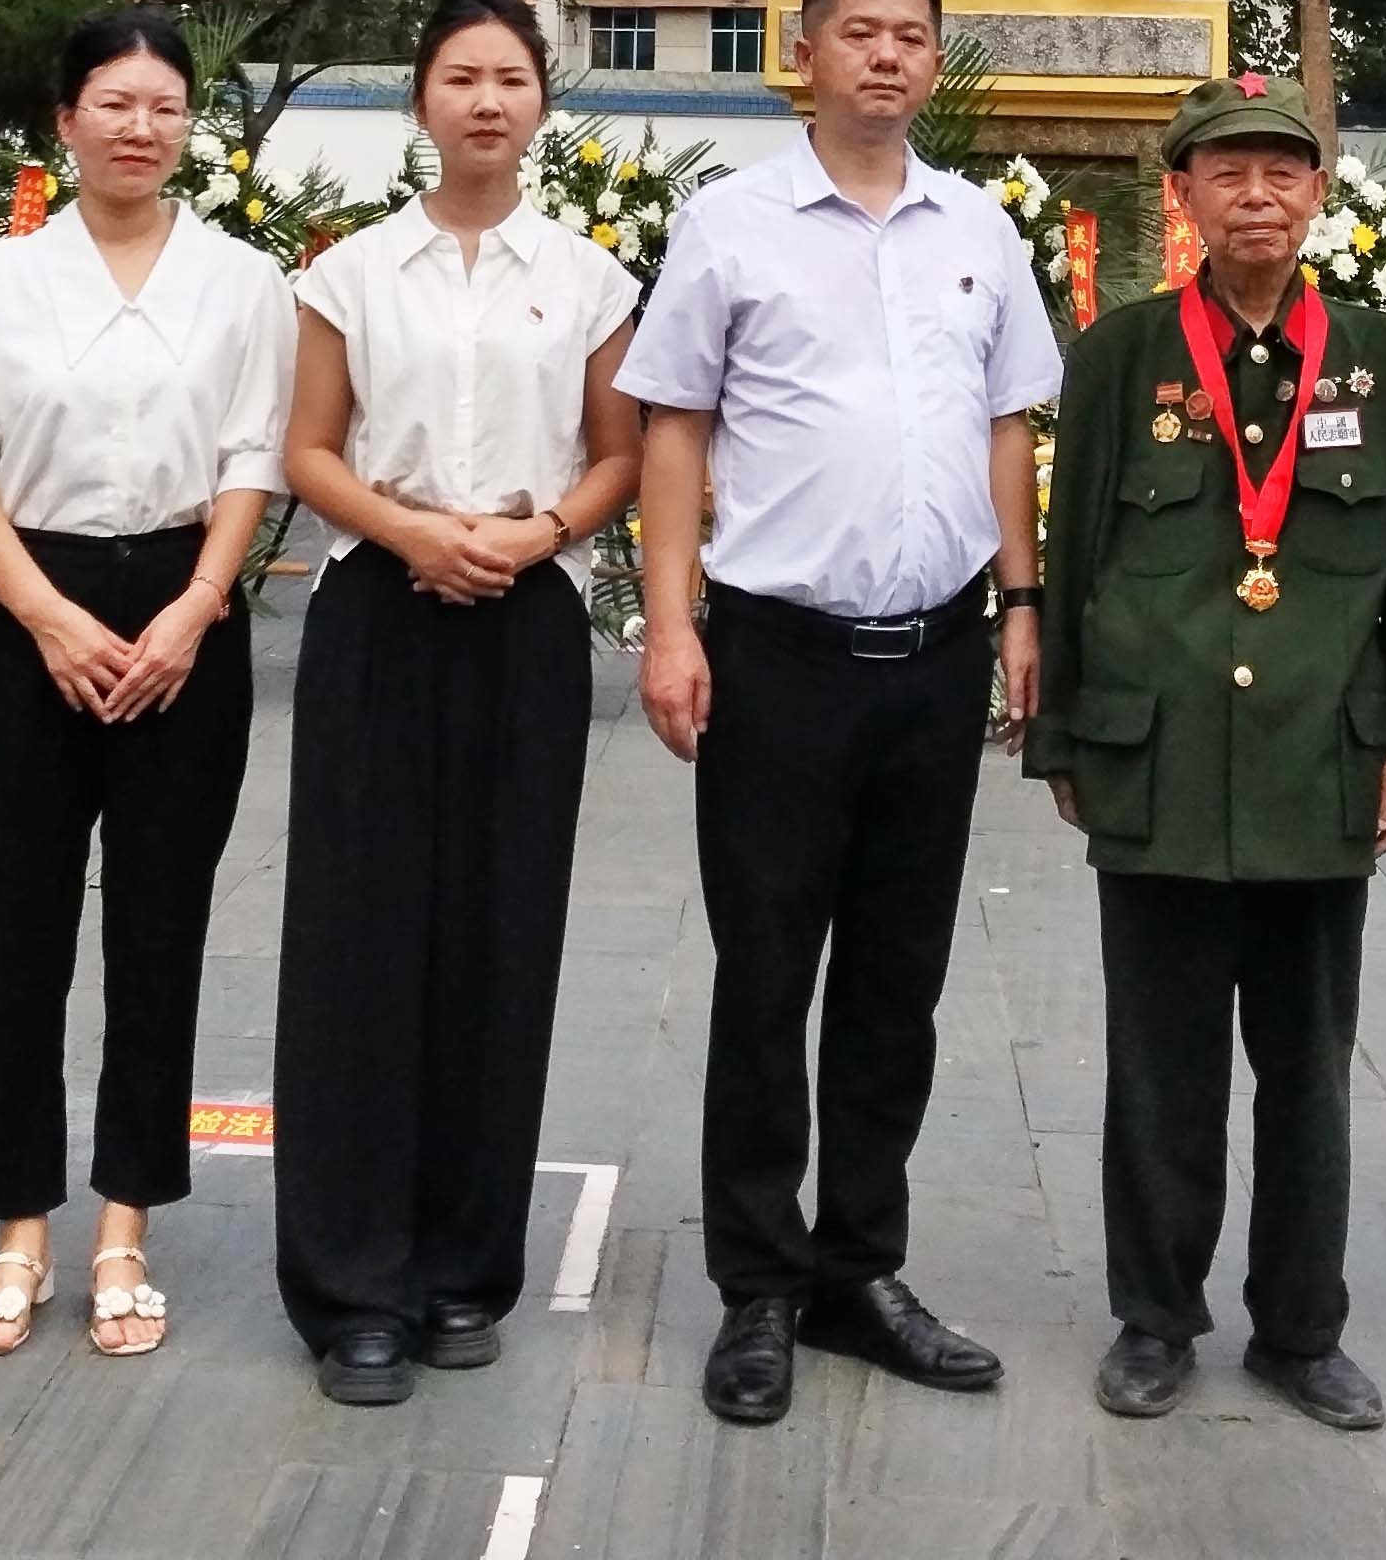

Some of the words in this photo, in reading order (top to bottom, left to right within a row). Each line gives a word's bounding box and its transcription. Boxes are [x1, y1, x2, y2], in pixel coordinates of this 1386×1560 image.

[1071, 225, 1090, 332] 英雄烈
[190, 1109, 274, 1137] 检法
